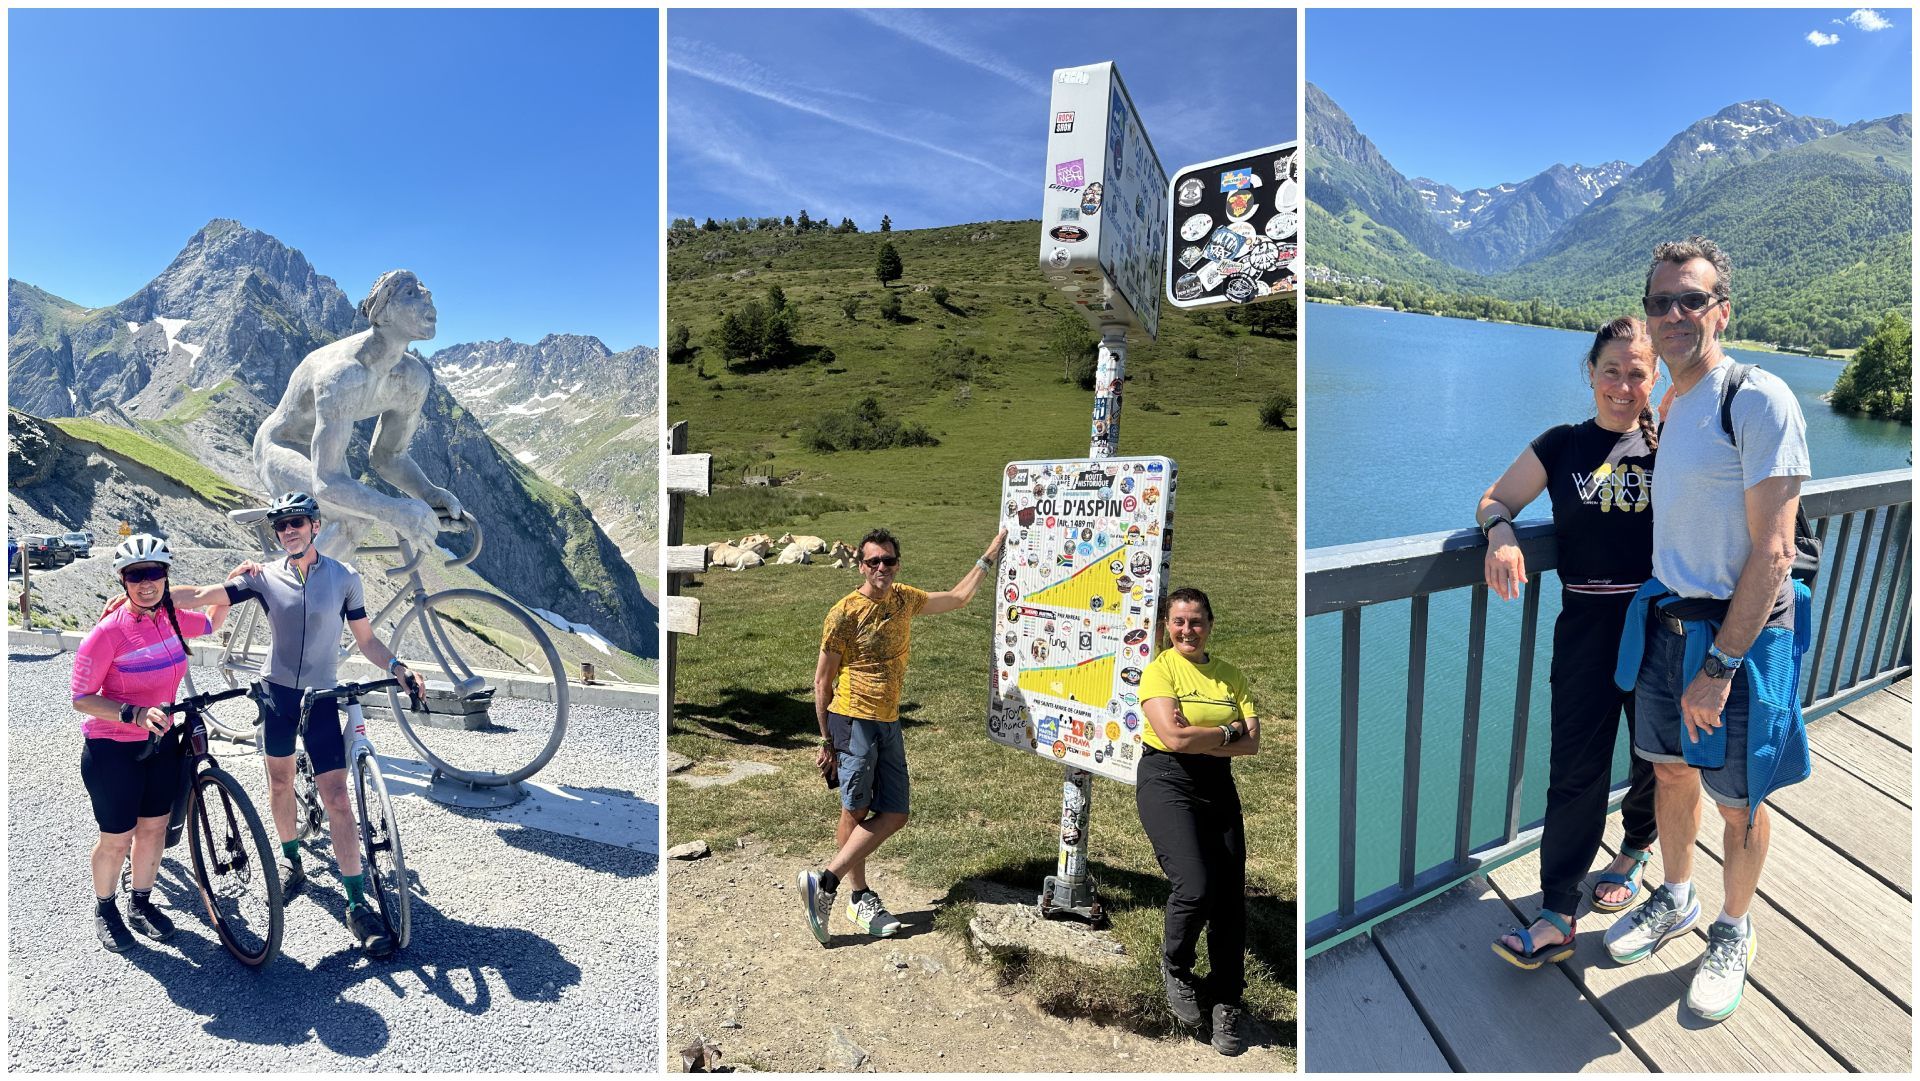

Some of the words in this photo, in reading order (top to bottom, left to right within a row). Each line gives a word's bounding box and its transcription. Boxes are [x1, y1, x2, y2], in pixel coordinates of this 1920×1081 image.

[1057, 113, 1073, 122] ROCK
[1049, 183, 1080, 194] GIANT
[1084, 473, 1103, 481] ROUTE
[1572, 472, 1653, 488] WONDE
[1077, 480, 1110, 488] HISTORIQUE
[1577, 484, 1650, 503] WOMA
[1035, 499, 1059, 516] COL
[1063, 499, 1122, 517] D'ASPIN
[1057, 519, 1070, 528] (Alt.
[1086, 520, 1095, 529] m)
[1063, 734, 1090, 749] STRAVA
